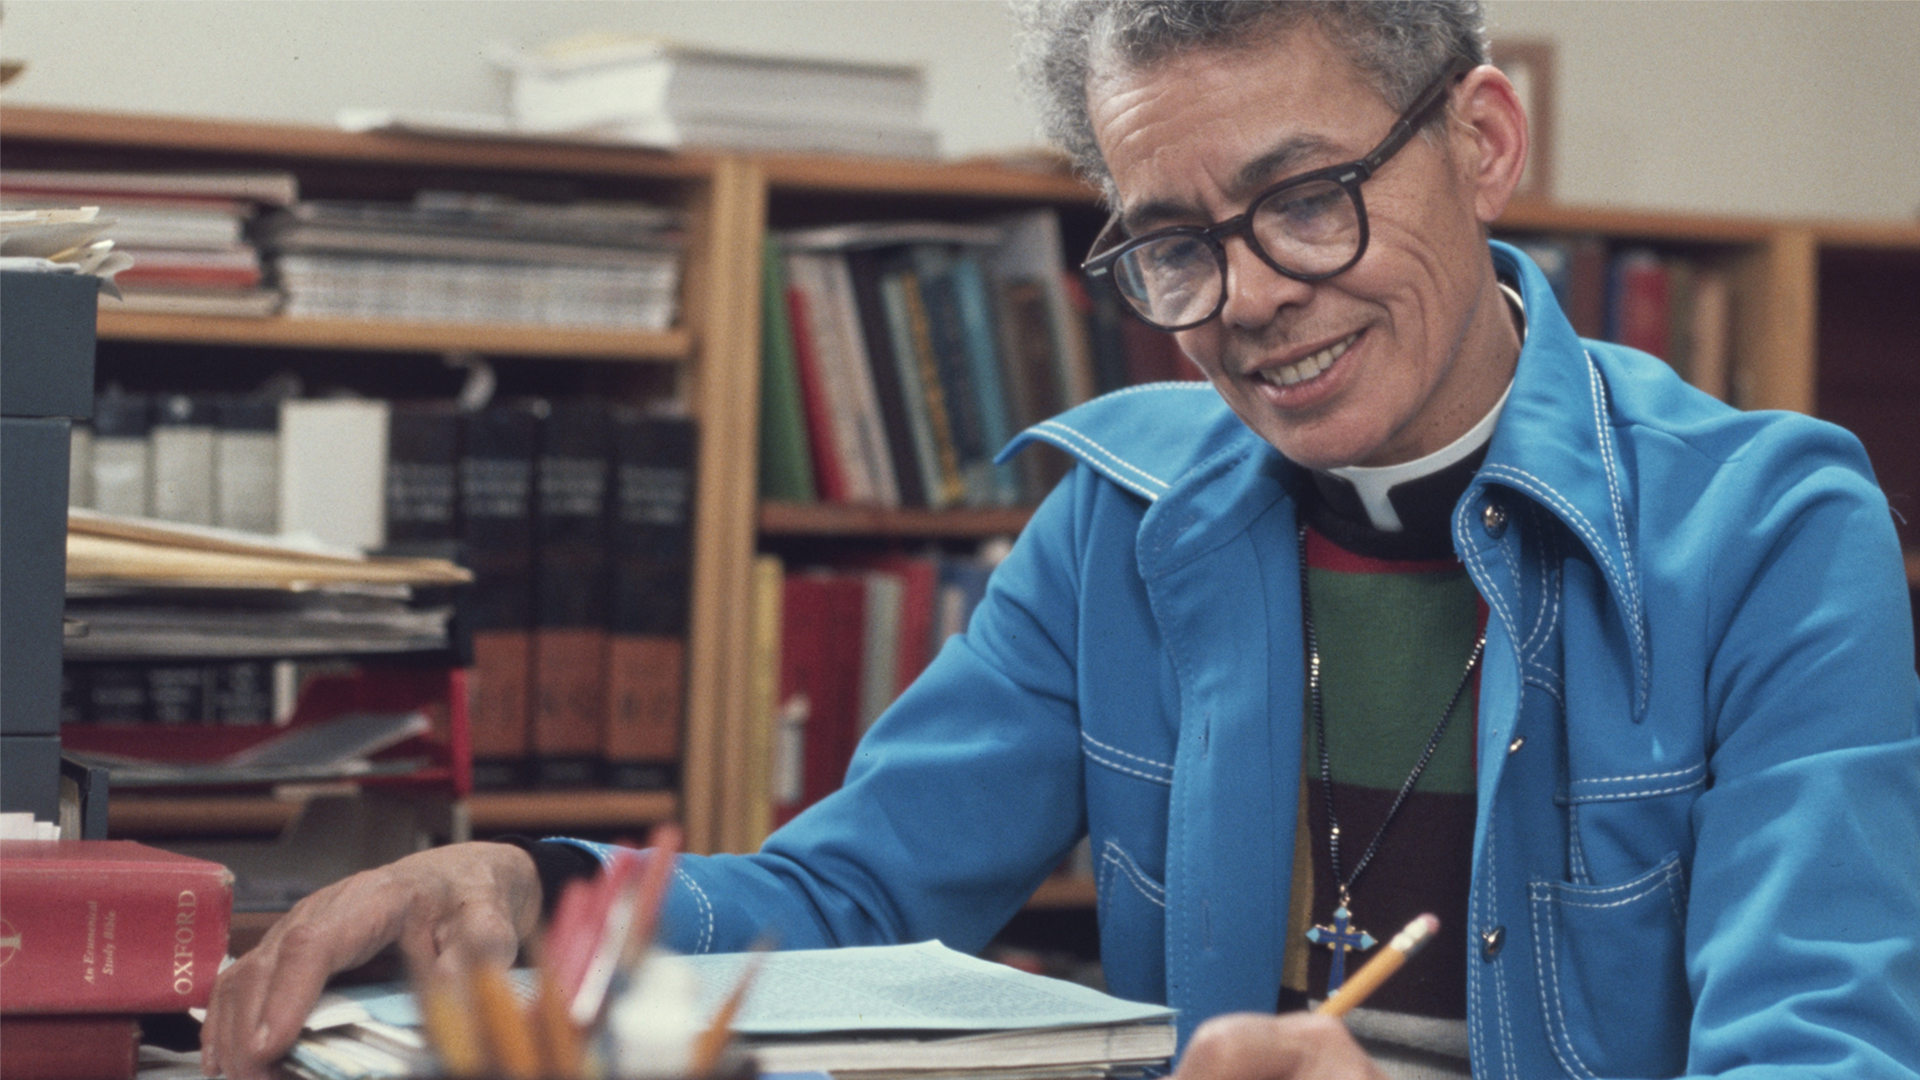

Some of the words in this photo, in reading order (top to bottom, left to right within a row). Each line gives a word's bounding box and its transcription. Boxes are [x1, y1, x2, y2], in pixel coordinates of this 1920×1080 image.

[83, 900, 98, 964] Ecumenical
[104, 910, 116, 940] Bible
[173, 890, 197, 995] OXFORD
[102, 943, 116, 975] Study
[84, 967, 95, 984] An
